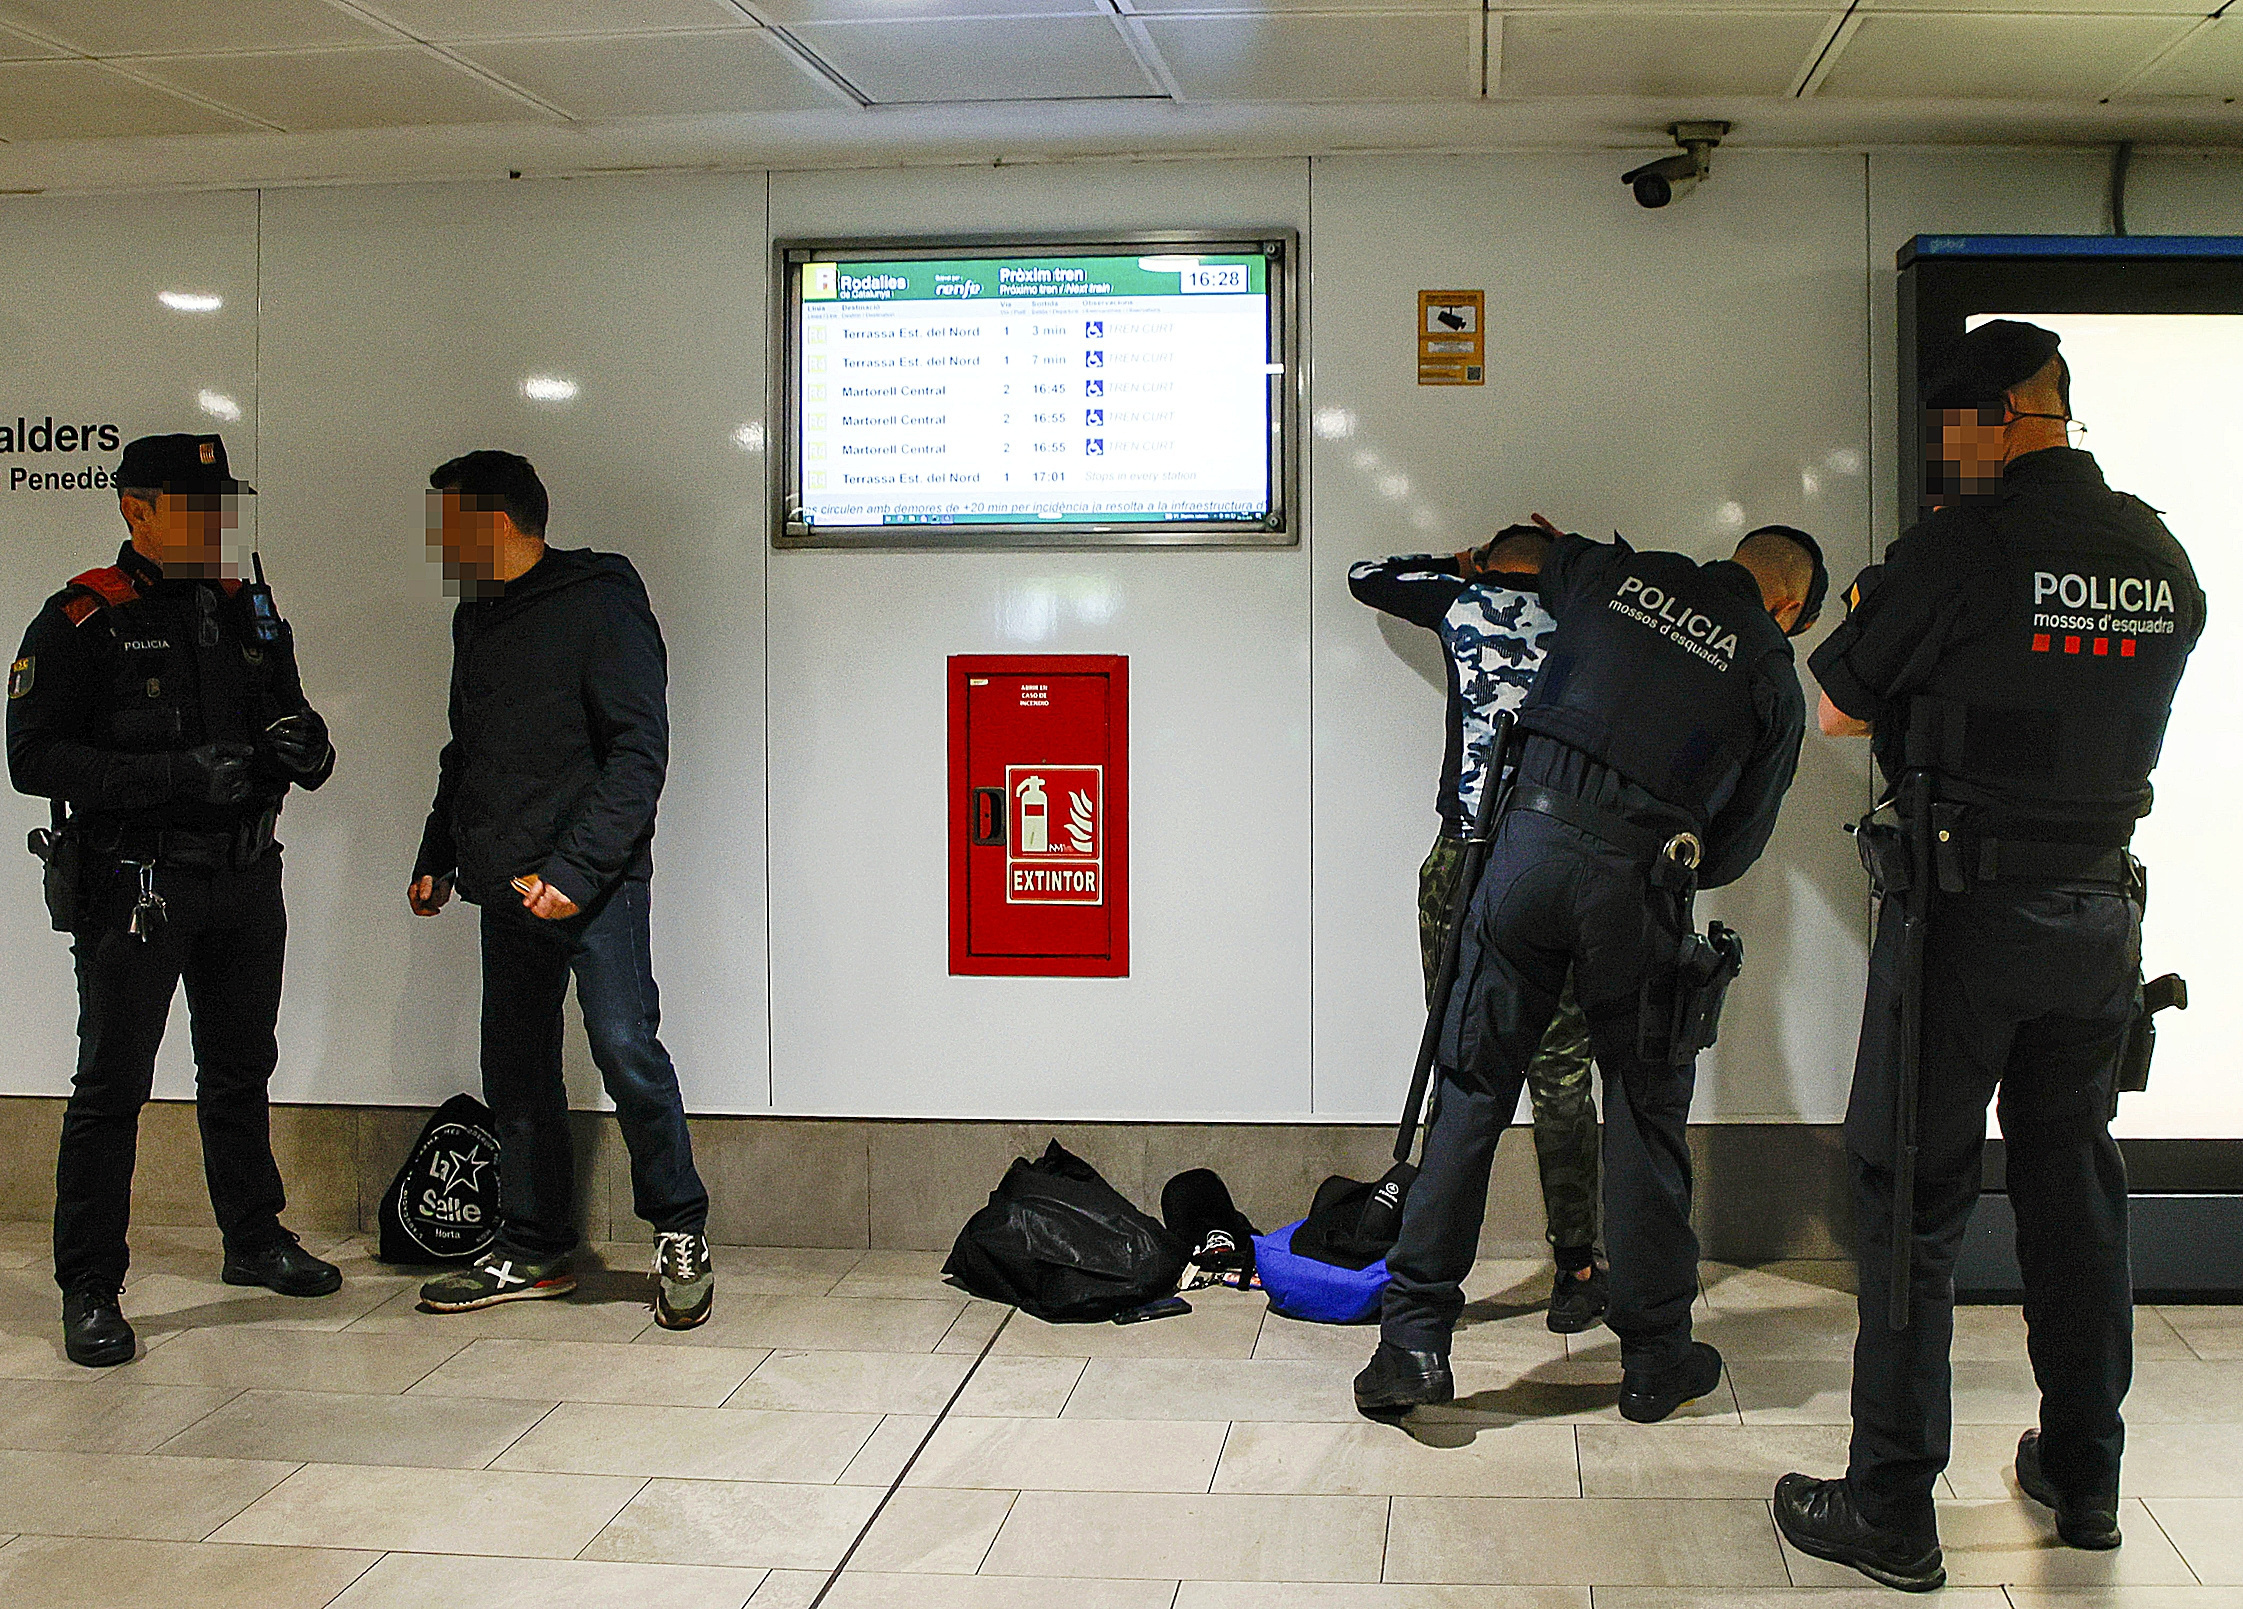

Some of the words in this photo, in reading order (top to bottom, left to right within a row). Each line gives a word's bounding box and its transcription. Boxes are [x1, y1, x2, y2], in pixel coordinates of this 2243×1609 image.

[1054, 268, 1086, 282] tren
[1189, 272, 1240, 287] 16:28
[840, 275, 908, 290] Rodalies
[935, 280, 983, 299] renfe
[842, 329, 895, 339] Terrassa
[899, 328, 922, 338] Est.
[927, 327, 946, 337] del
[949, 327, 980, 336] Nord
[1032, 325, 1039, 336] 3
[1043, 325, 1066, 335] min
[842, 358, 895, 368] Terrassa
[899, 357, 922, 367] Est.
[927, 356, 946, 366] del
[949, 356, 980, 365] Nord
[1032, 355, 1039, 365] 7
[1043, 354, 1066, 364] min
[842, 387, 897, 397] Martorell
[901, 386, 946, 396] Central
[1003, 384, 1010, 394] 2
[1033, 384, 1066, 394] 16:45
[842, 416, 897, 426] Martorell
[901, 415, 946, 425] Central
[1003, 413, 1010, 423] 2
[1034, 413, 1066, 423] 16:55
[842, 445, 897, 455] Martorell
[901, 444, 946, 454] Central
[1003, 443, 1010, 453] 2
[1034, 443, 1066, 452] 16:55
[842, 475, 895, 485] Terrassa
[899, 474, 922, 484] Est.
[927, 473, 946, 483] del
[949, 473, 980, 482] Nord
[1033, 472, 1065, 482] 17:01
[820, 504, 864, 514] circulen
[866, 504, 890, 514] amb
[894, 503, 942, 513] demores
[945, 503, 960, 513] de
[963, 503, 985, 512] +20
[987, 502, 1009, 512] min
[1011, 503, 1030, 514] per
[1032, 501, 1089, 512] incidència
[1091, 501, 1102, 514] ja
[1105, 501, 1144, 511] resolta
[1147, 503, 1155, 511] a
[1157, 500, 1168, 511] la
[1171, 500, 1253, 511] infraestructura
[2034, 571, 2175, 613] POLICIA
[1608, 599, 1659, 629] mossos
[1616, 575, 1738, 660] POLICIA
[2033, 613, 2095, 630] mossos
[2098, 614, 2175, 636] d'esquadra
[124, 640, 170, 651] POLICIA
[1013, 869, 1096, 892] EXTINTOR
[419, 1188, 482, 1223] Salle
[435, 1227, 461, 1240] Horta
